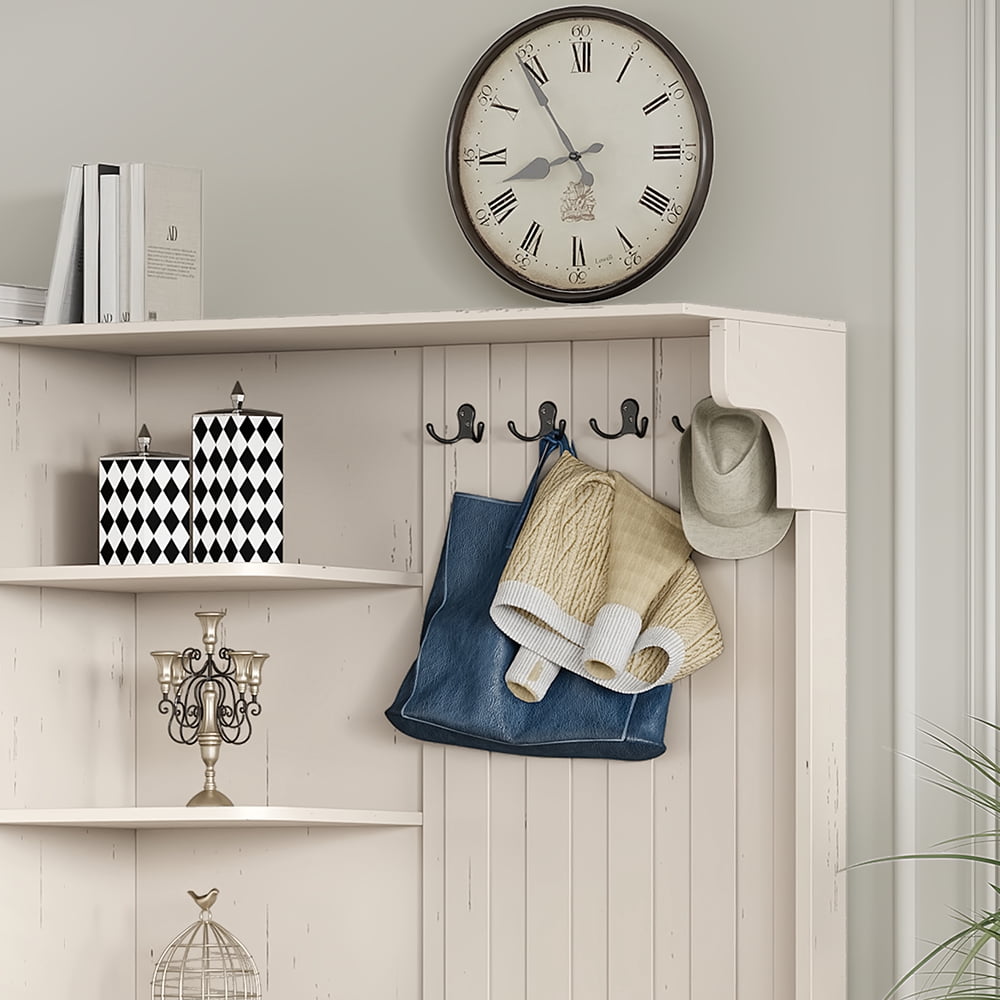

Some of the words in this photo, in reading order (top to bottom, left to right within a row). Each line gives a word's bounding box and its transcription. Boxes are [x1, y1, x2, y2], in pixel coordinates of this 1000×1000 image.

[571, 24, 592, 38] 60
[517, 39, 534, 58] 55
[631, 39, 643, 52] 5
[570, 41, 592, 73] XII
[477, 84, 493, 107] 50
[668, 80, 685, 100] 10
[490, 94, 520, 121] X
[463, 147, 476, 168] 45
[652, 145, 681, 161] III
[685, 143, 697, 162] 15
[475, 208, 491, 227] 40
[667, 202, 684, 225] 20
[166, 225, 178, 241] AD
[512, 253, 532, 271] 35
[624, 250, 642, 271] 25
[568, 270, 588, 285] 30
